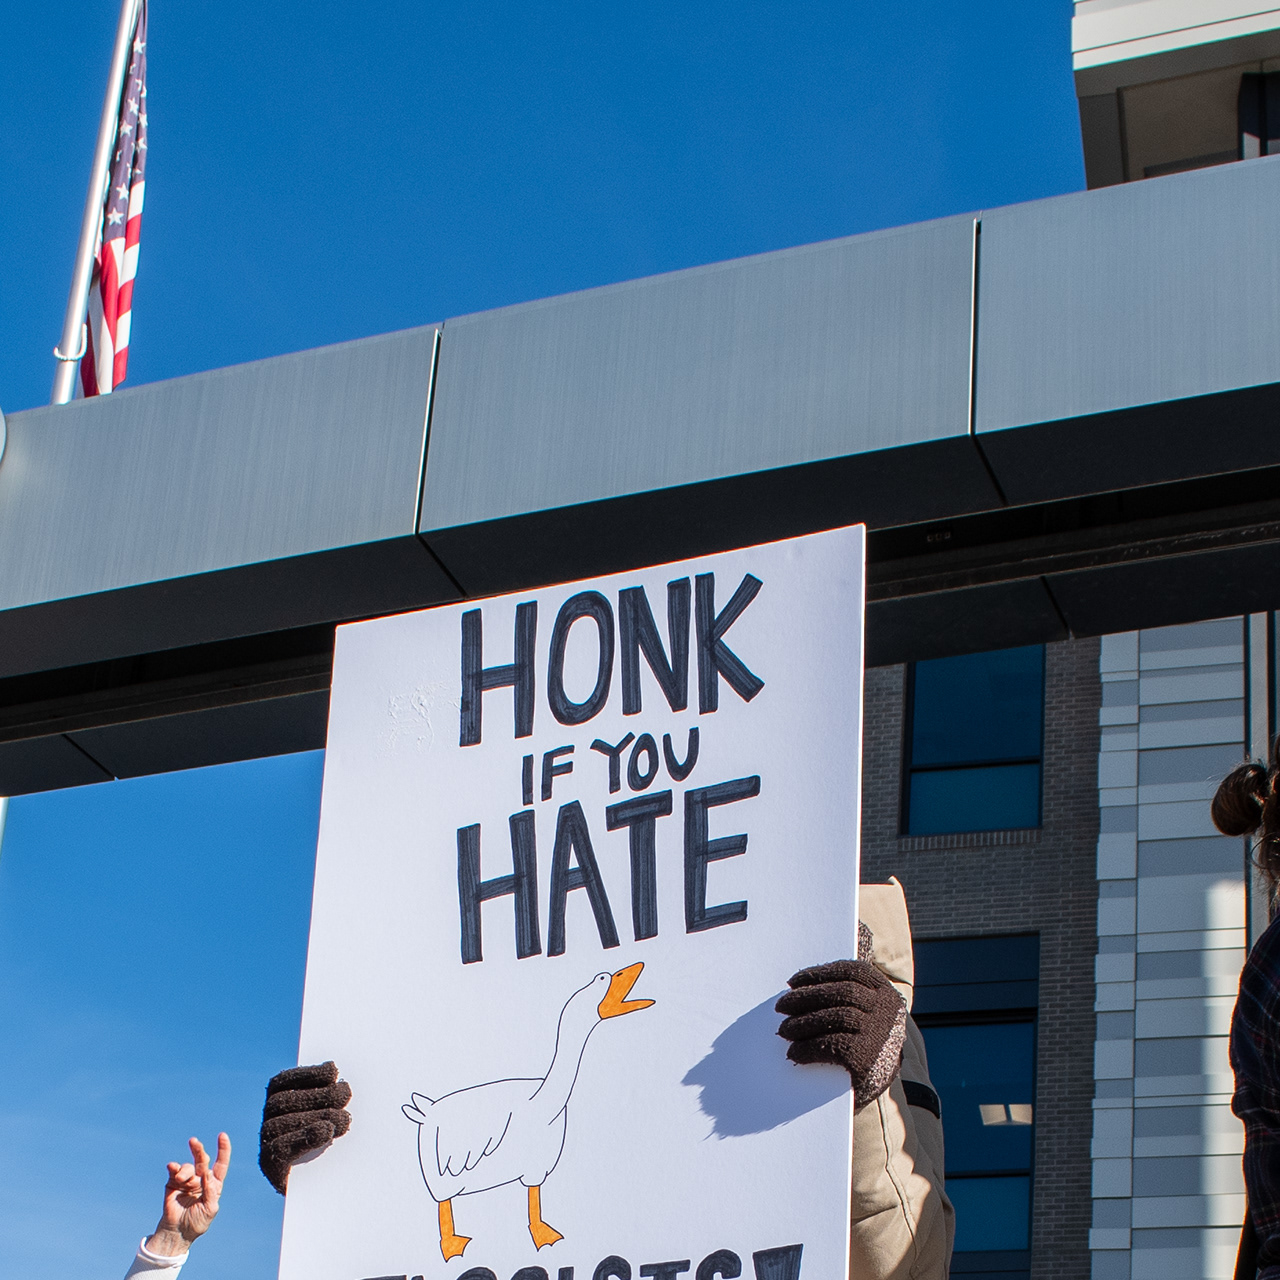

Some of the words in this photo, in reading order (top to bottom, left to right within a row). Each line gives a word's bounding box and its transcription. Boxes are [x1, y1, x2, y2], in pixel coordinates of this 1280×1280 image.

[459, 571, 765, 748] HONK
[521, 744, 575, 806] IF
[589, 727, 700, 794] YOU
[456, 774, 761, 964] HATE
